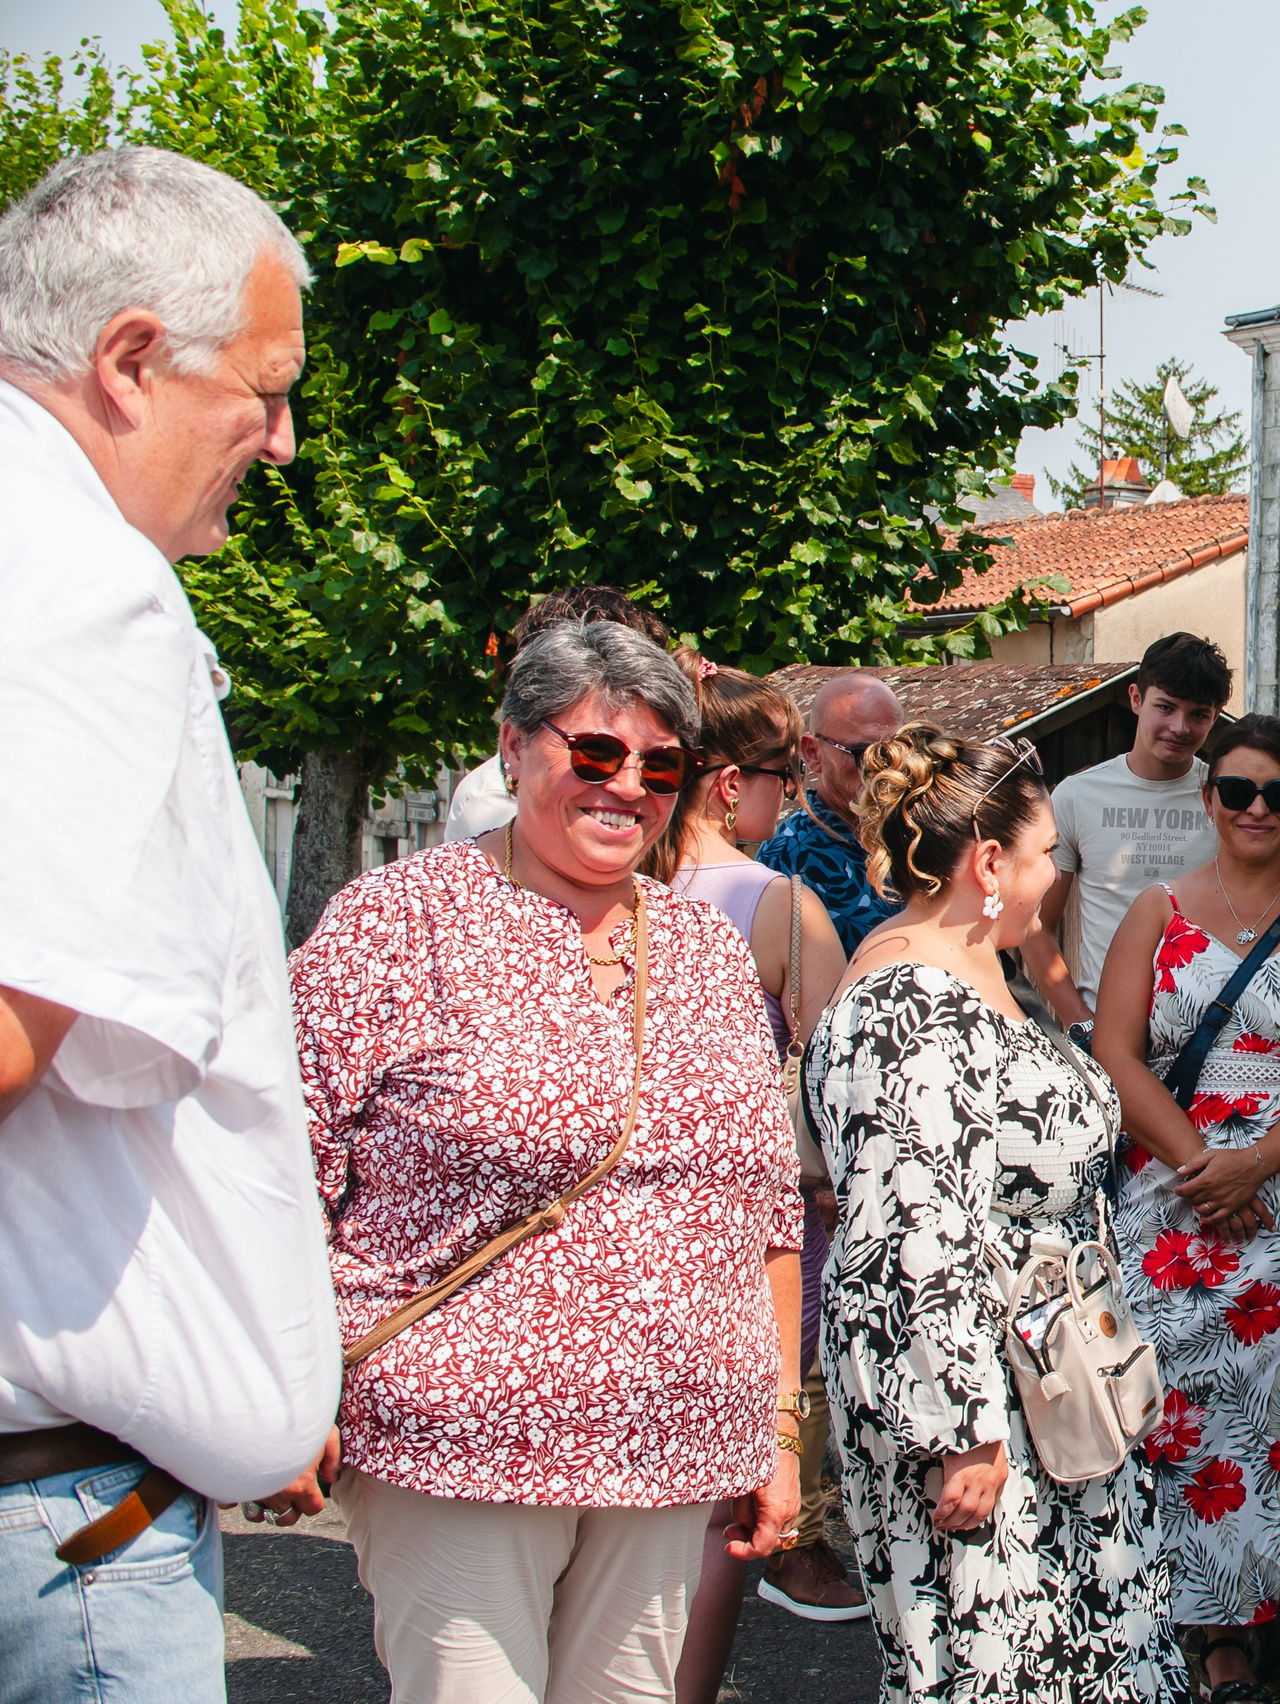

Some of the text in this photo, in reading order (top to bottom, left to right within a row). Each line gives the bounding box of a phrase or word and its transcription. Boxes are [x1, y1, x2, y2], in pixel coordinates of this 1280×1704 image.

[1101, 807, 1210, 831] NEW YORK
[1120, 832, 1131, 840] 90
[1131, 831, 1162, 841] Bedford
[1135, 842, 1172, 852] NY 10014
[1121, 854, 1185, 866] WEST VILLAGE
